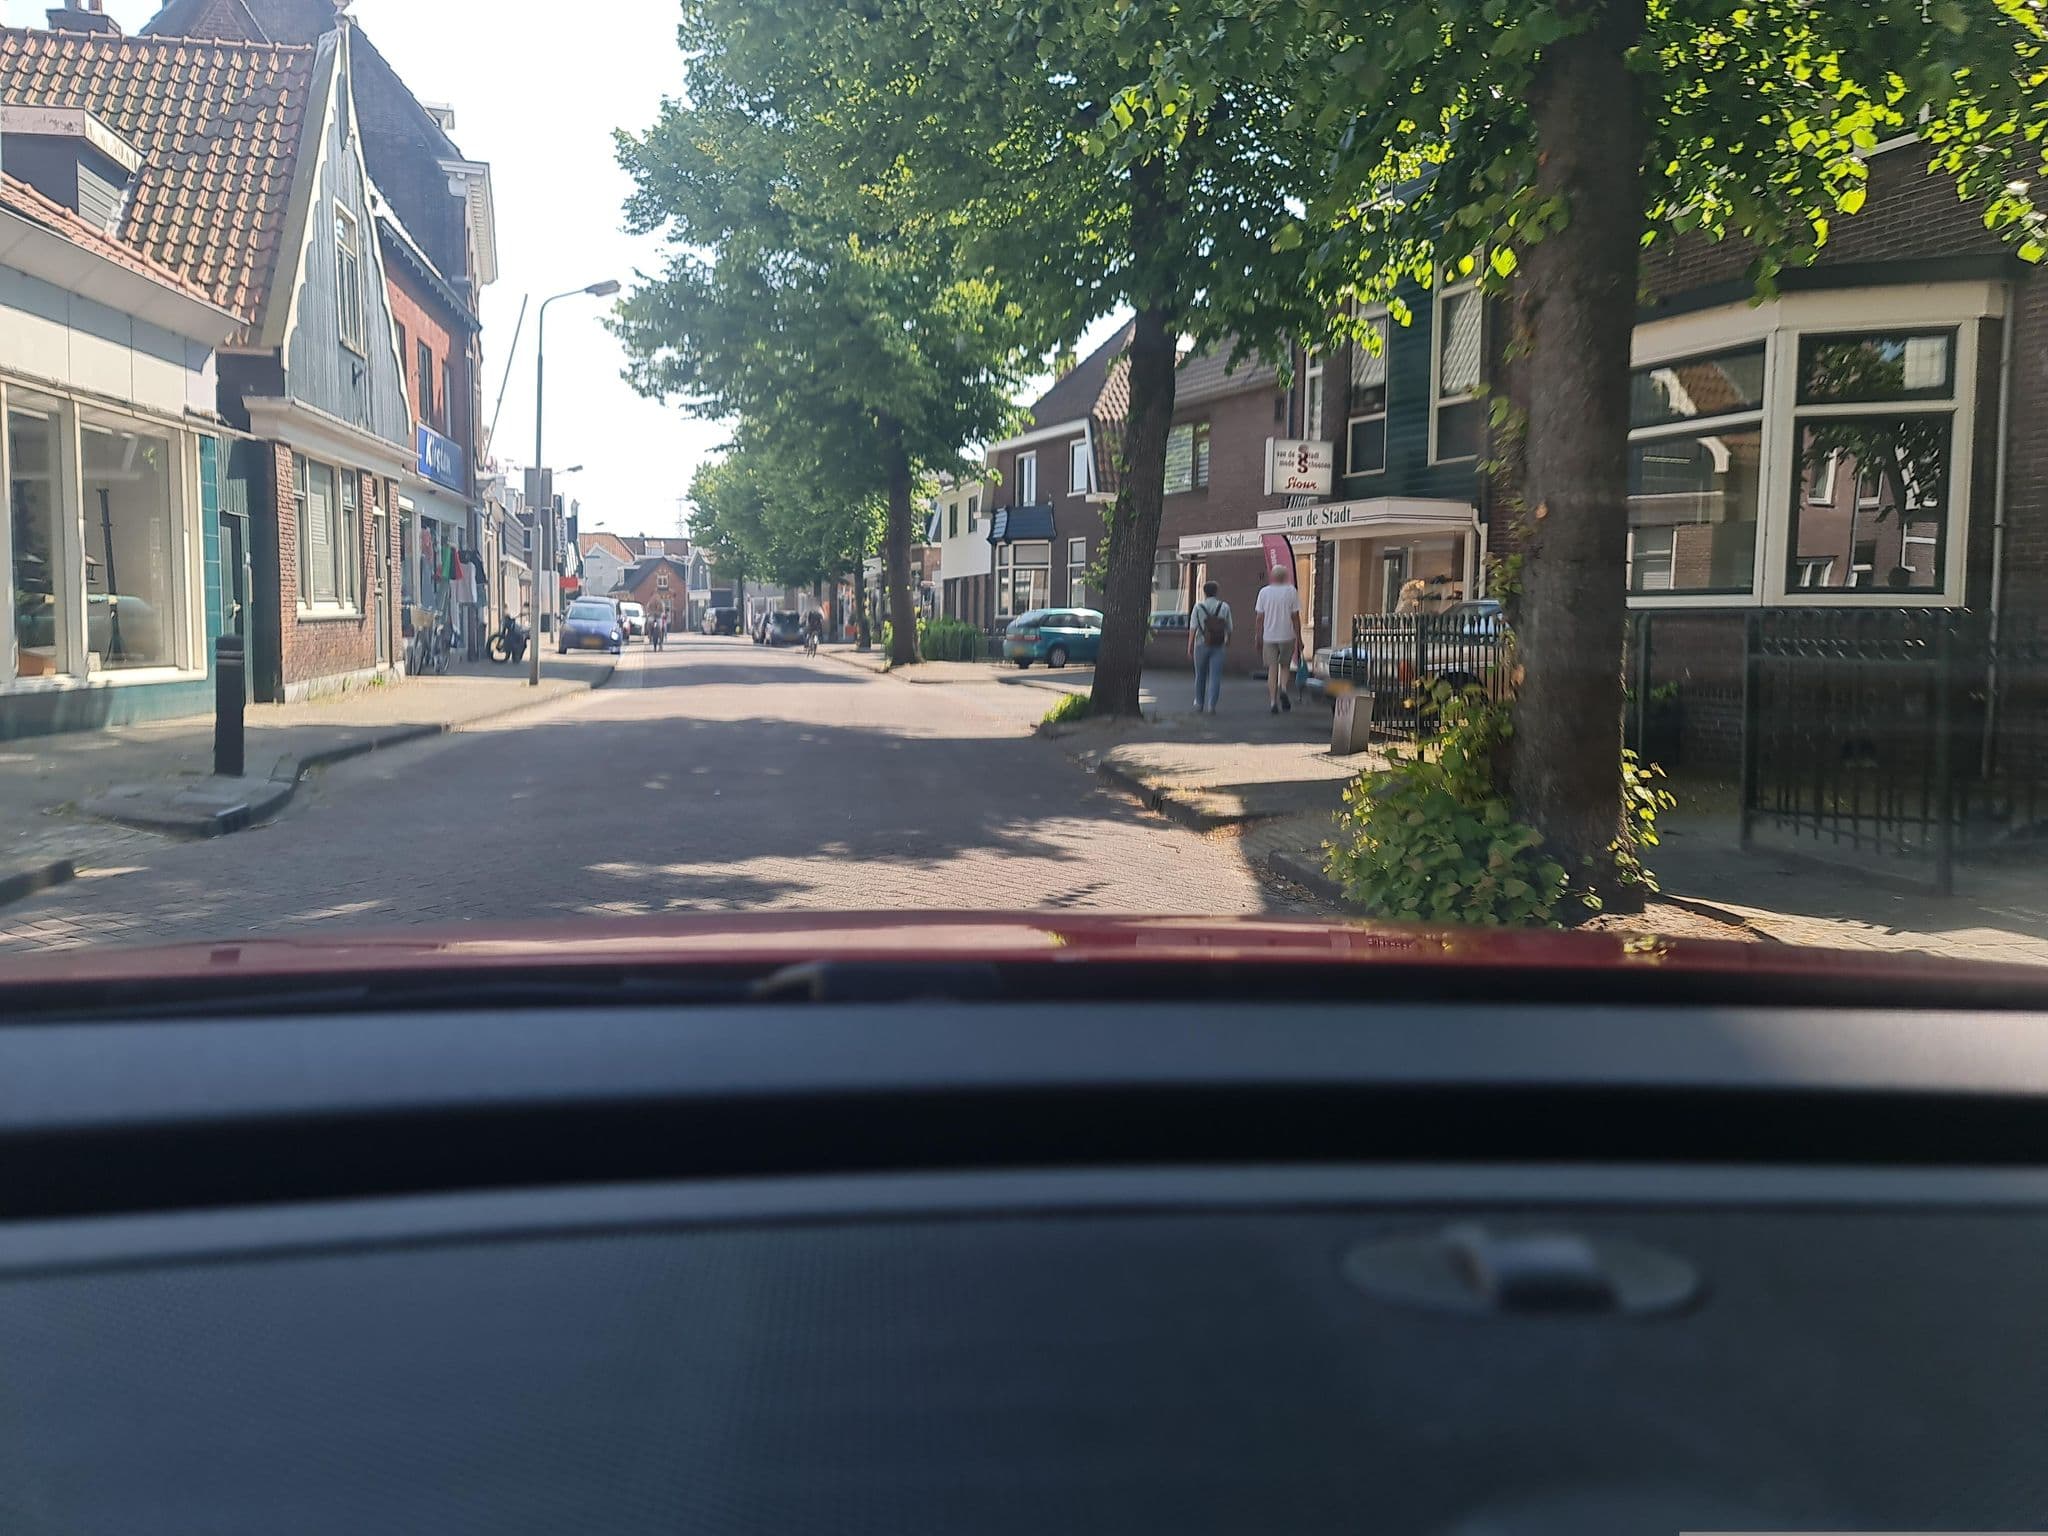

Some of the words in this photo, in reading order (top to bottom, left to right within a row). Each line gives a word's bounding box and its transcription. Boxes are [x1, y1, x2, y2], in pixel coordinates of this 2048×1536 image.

[1286, 512, 1303, 528] van
[1306, 510, 1319, 525] de
[1321, 506, 1351, 524] Stadt
[1200, 539, 1214, 549] van
[1215, 536, 1224, 548] de
[1225, 533, 1244, 547] Stadt
